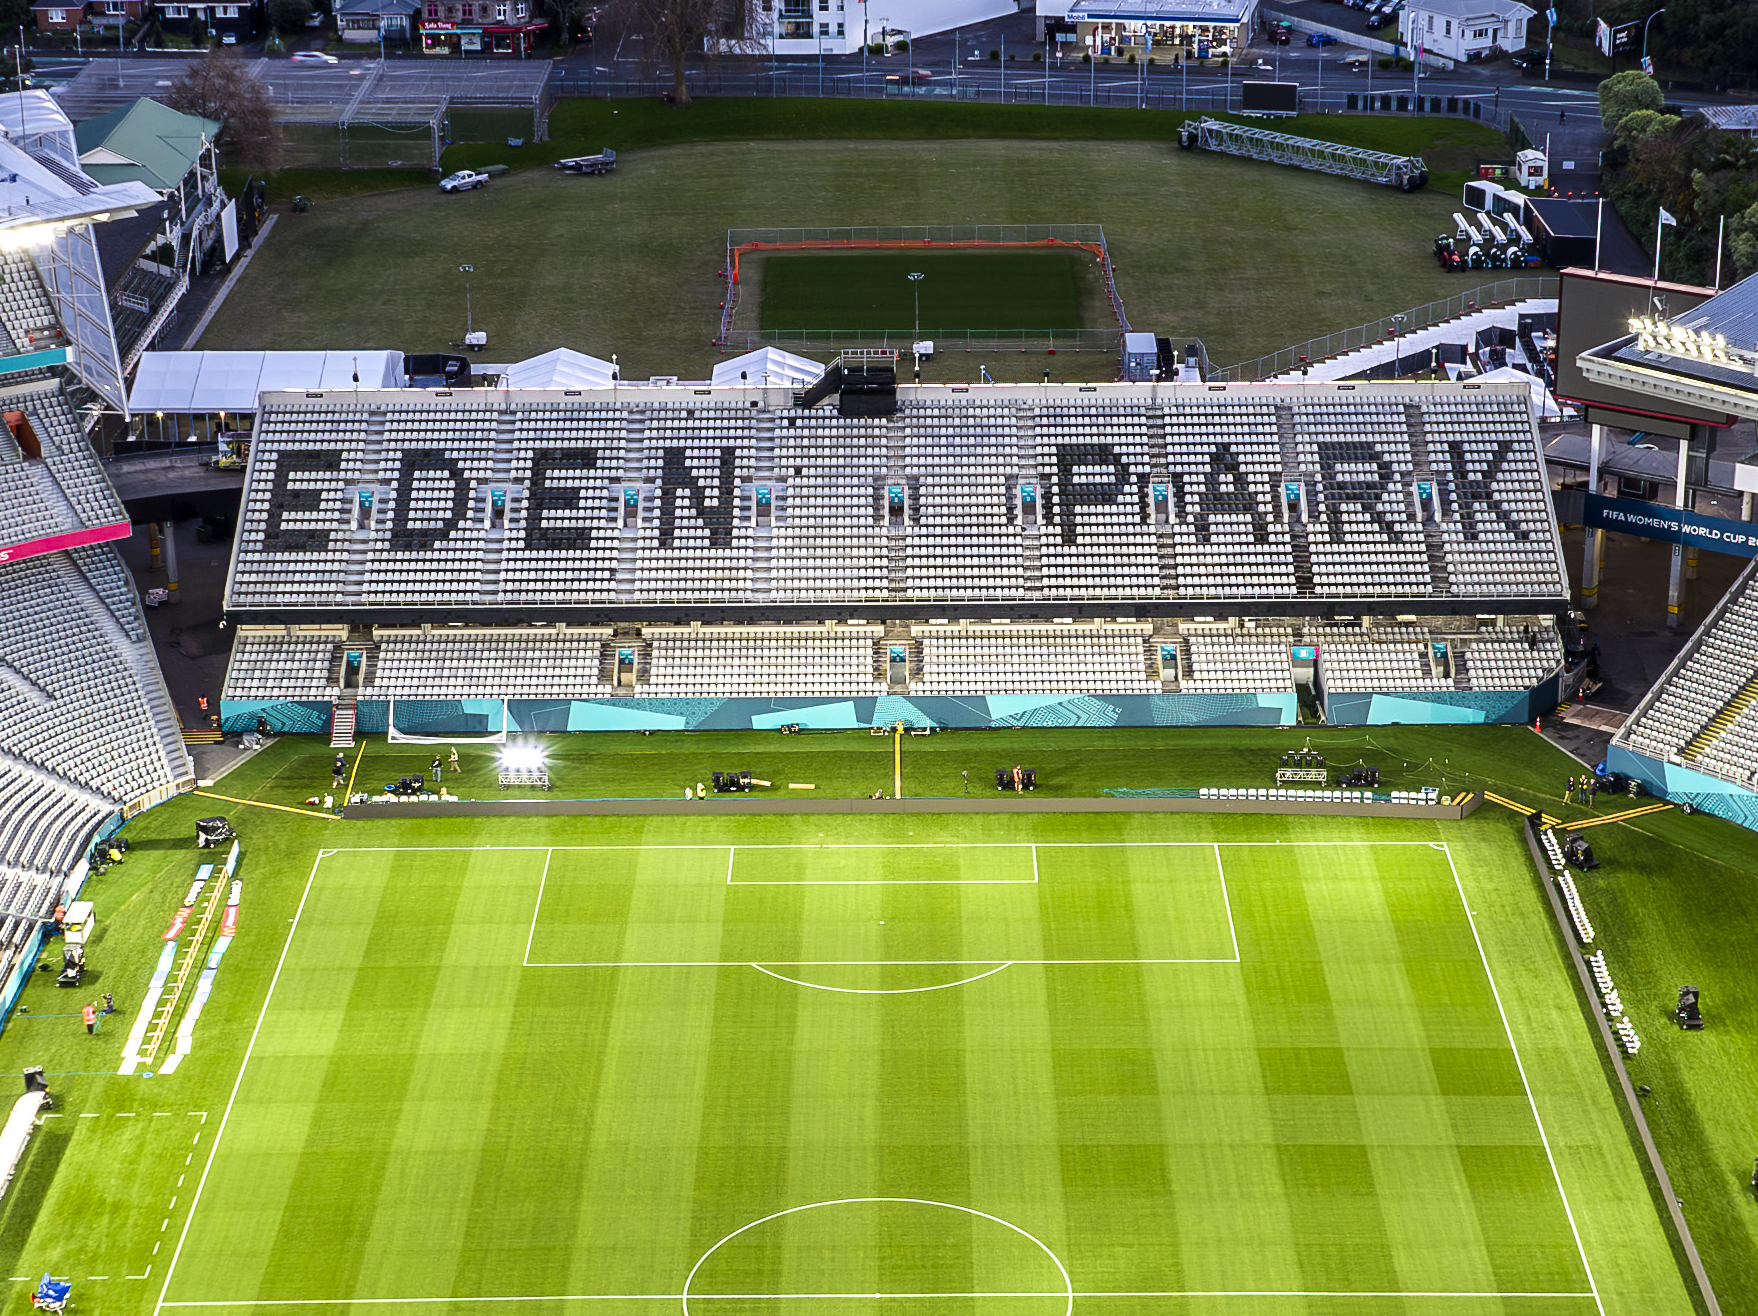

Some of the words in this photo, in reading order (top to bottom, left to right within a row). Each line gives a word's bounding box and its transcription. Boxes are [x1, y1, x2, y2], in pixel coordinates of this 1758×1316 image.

[1066, 13, 1086, 21] Mobil
[261, 444, 735, 551] EDEN
[1053, 439, 1535, 547] PARK
[1602, 509, 1624, 522] FIFA
[1626, 512, 1679, 532] WOMEN'S
[1681, 523, 1720, 541] WORLD
[1722, 530, 1747, 545] CUP
